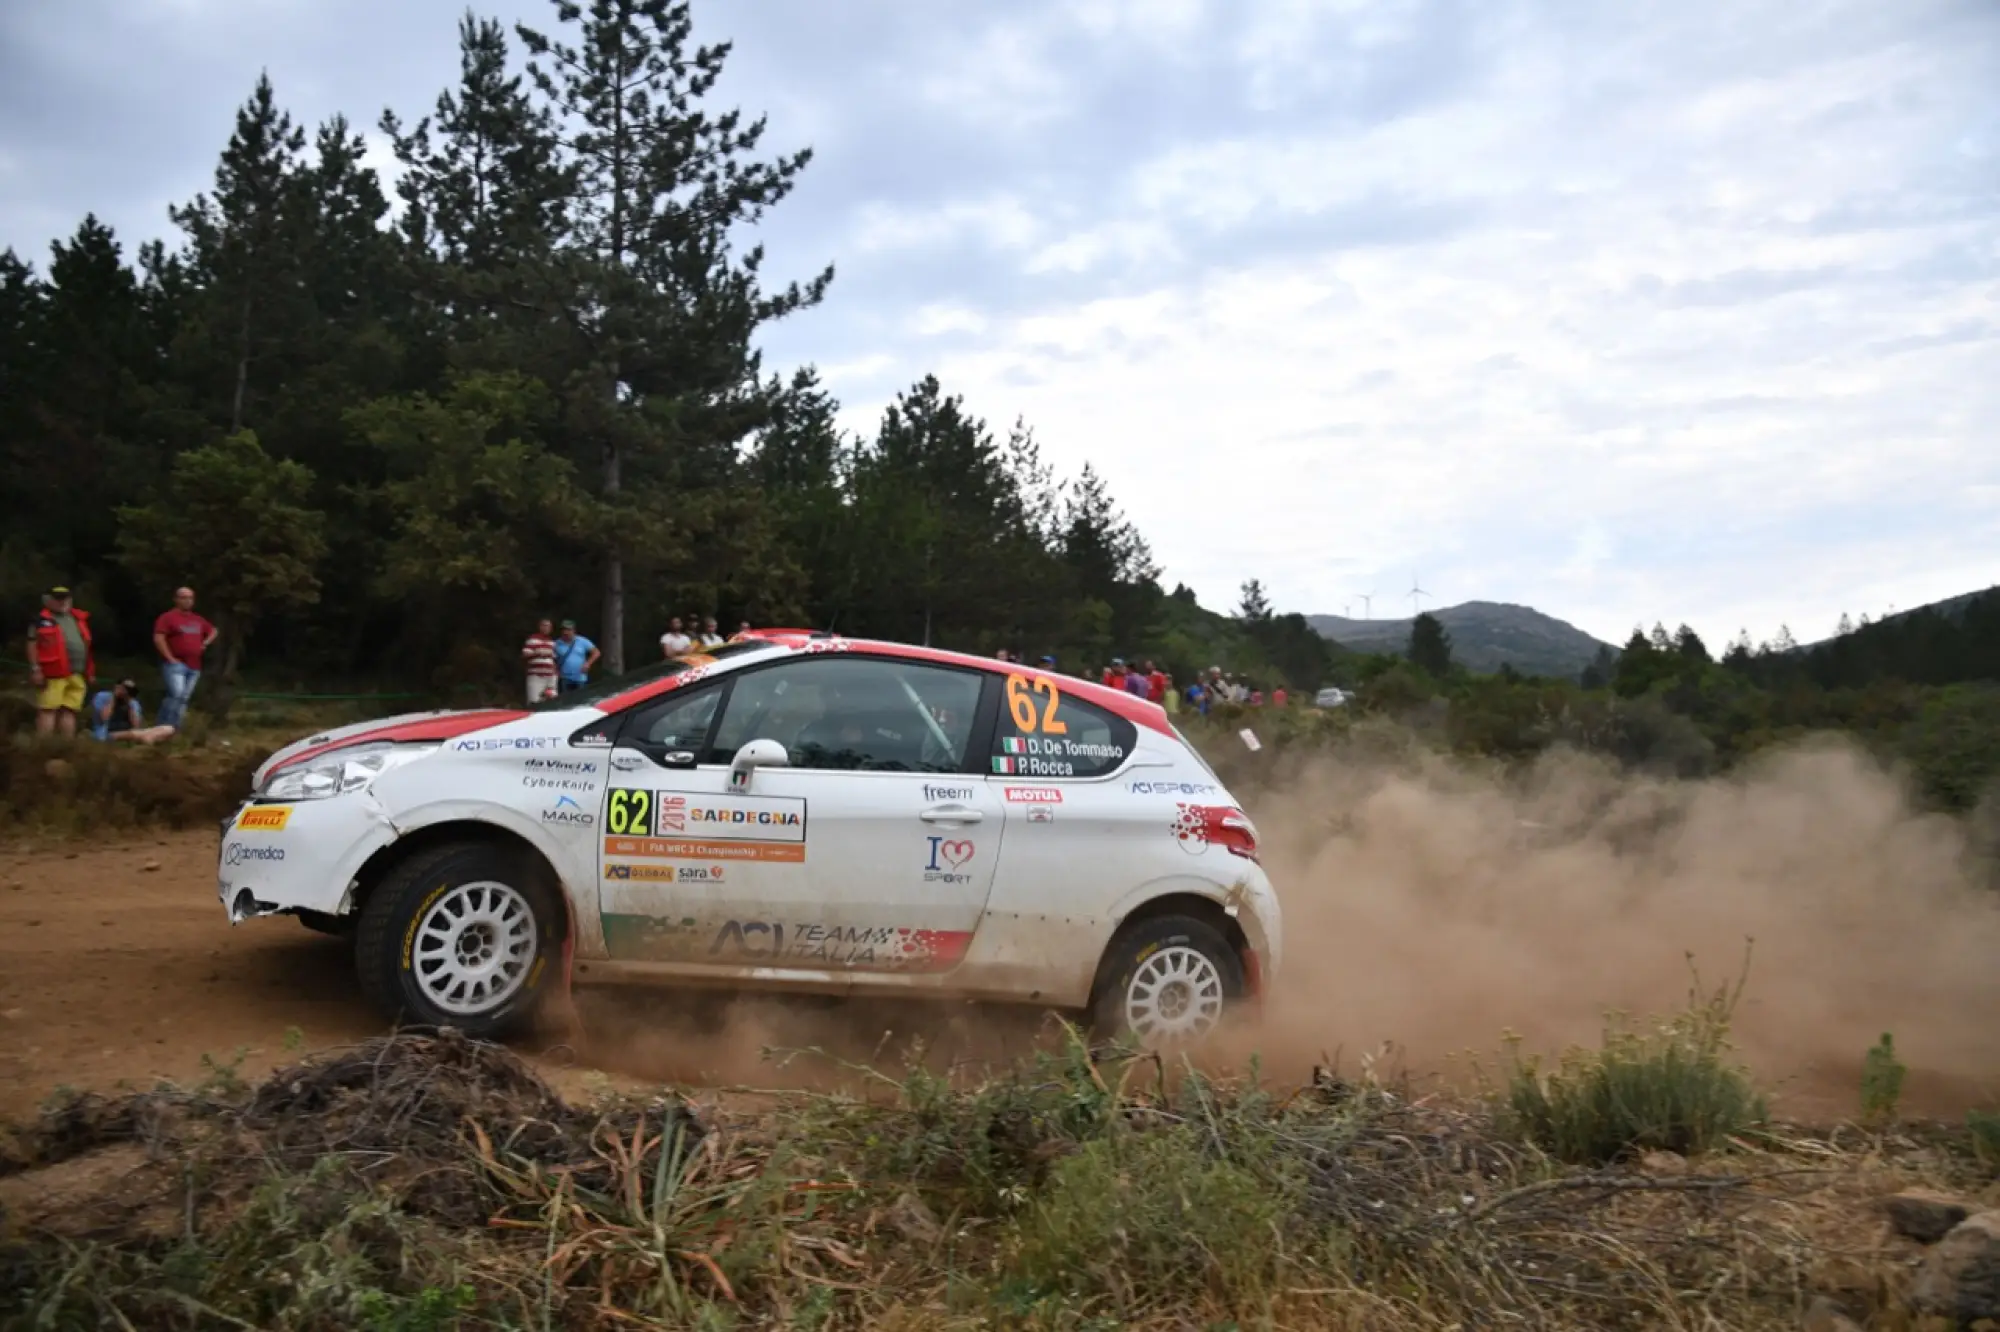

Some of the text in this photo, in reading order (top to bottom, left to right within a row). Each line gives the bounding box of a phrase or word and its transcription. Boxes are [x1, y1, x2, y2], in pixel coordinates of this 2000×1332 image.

[1007, 672, 1067, 734] 62
[1028, 739, 1123, 758] D. De Tommaso
[1030, 758, 1073, 775] Rocca
[523, 776, 595, 792] CyberKnife
[924, 784, 973, 801] freem
[1007, 788, 1061, 801] MOTUL
[241, 810, 286, 827] PIRELLI
[541, 810, 595, 824] MAKO
[609, 789, 649, 835] 62
[662, 795, 686, 832] 2016
[691, 808, 800, 826] SARDEGNA
[679, 867, 708, 879] sara
[923, 873, 971, 884] SPORT
[708, 919, 784, 959] ACI
[795, 924, 873, 944] TEAM
